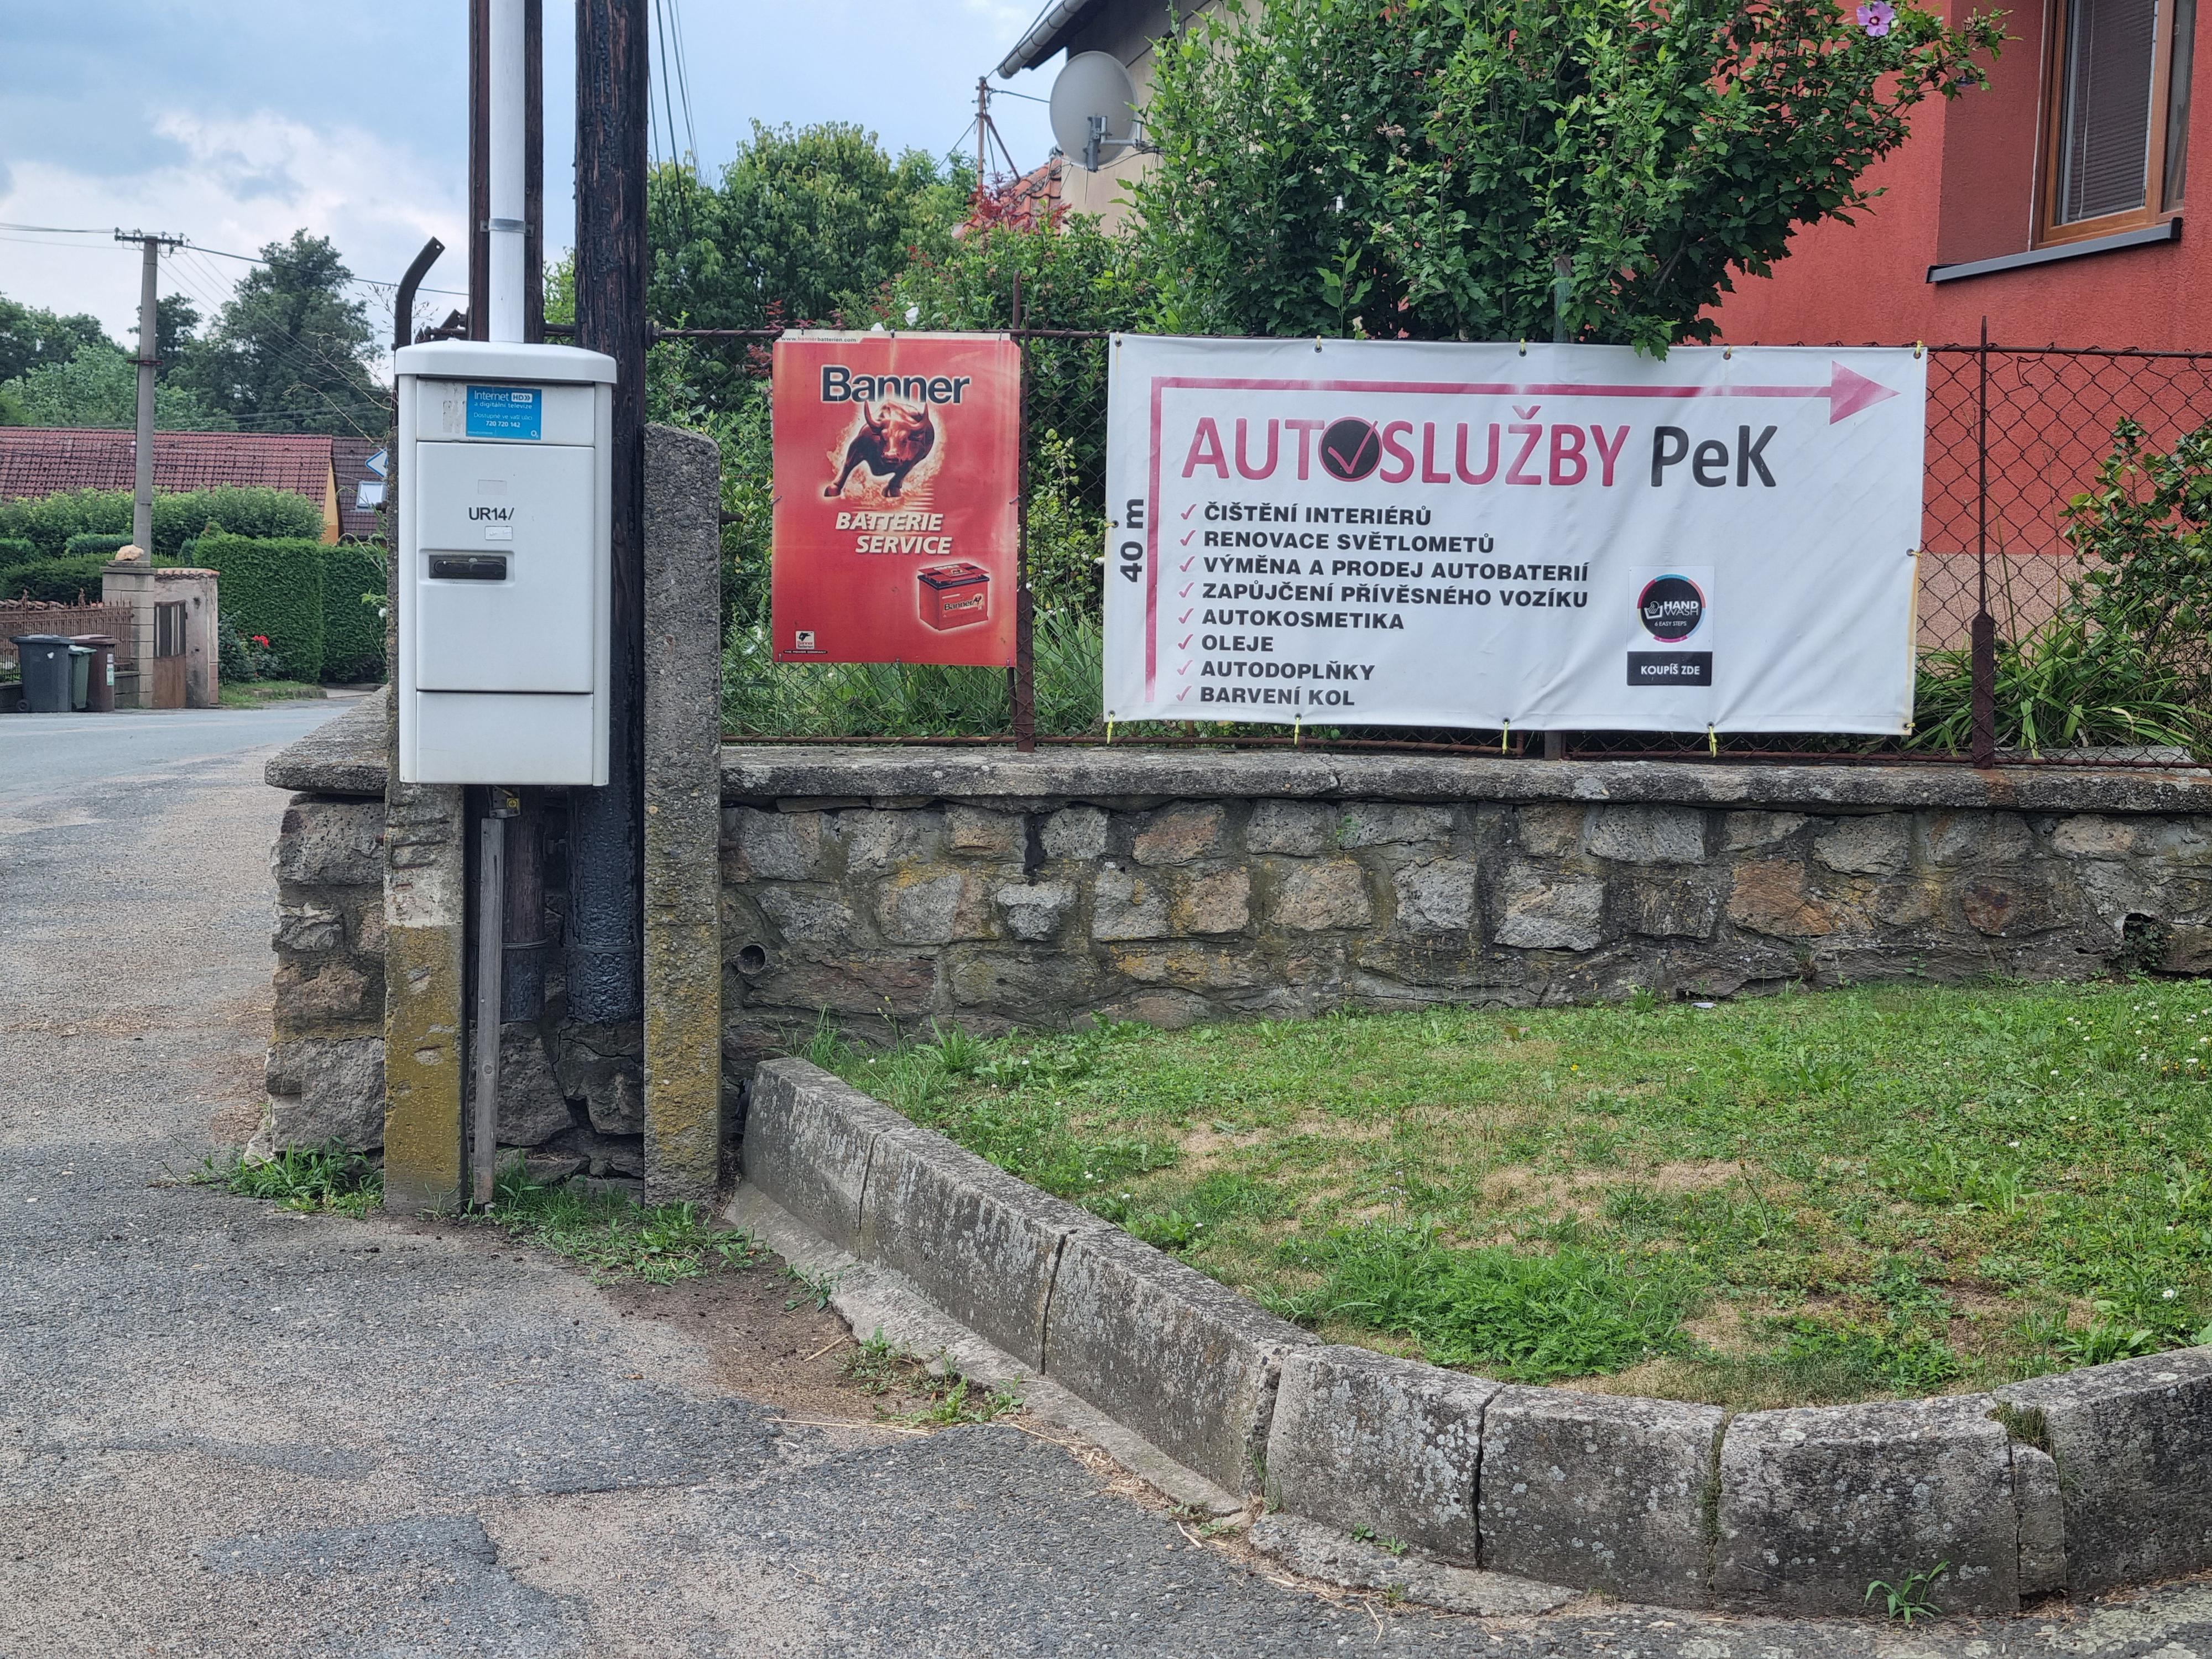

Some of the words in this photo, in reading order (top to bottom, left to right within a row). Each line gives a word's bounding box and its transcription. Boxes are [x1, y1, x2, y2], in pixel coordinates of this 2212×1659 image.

[821, 366, 971, 404] Banner
[474, 390, 509, 401] Internet
[1650, 425, 1778, 487] PeK
[468, 507, 515, 521] UR14/
[835, 512, 943, 531] BATTERIE
[1126, 499, 1144, 529] m
[1204, 501, 1298, 523] ČIŠTĚNÍ
[1305, 505, 1431, 526] INTERIÉRŮ
[855, 536, 953, 554] SERVICE
[1203, 531, 1329, 549] RENOVACE
[1336, 531, 1494, 554] SVĚTLOMETŮ
[1120, 541, 1143, 583] 40
[1203, 554, 1301, 575] VÝMĚNA
[1308, 560, 1324, 575] A
[1332, 560, 1423, 578] PRODEJ
[1430, 561, 1590, 582] AUTOBATERIÍ
[1202, 580, 1334, 602] ZAPŮJČENÍ
[1340, 583, 1491, 606] PŘÍVĚSNÉHO
[1499, 588, 1588, 608] VOZÍKU
[944, 601, 975, 611] Banner
[1663, 601, 1699, 609] HAND
[1202, 609, 1405, 629] AUTOKOSMETIKA
[1201, 634, 1274, 652] OLEJE
[1201, 660, 1375, 681] AUTODOPLŇKY
[1641, 664, 1678, 675] KOUPÍŠ
[1681, 666, 1700, 675] ZDE
[1200, 686, 1301, 705] BARVENÍ
[1308, 690, 1355, 706] KOL
